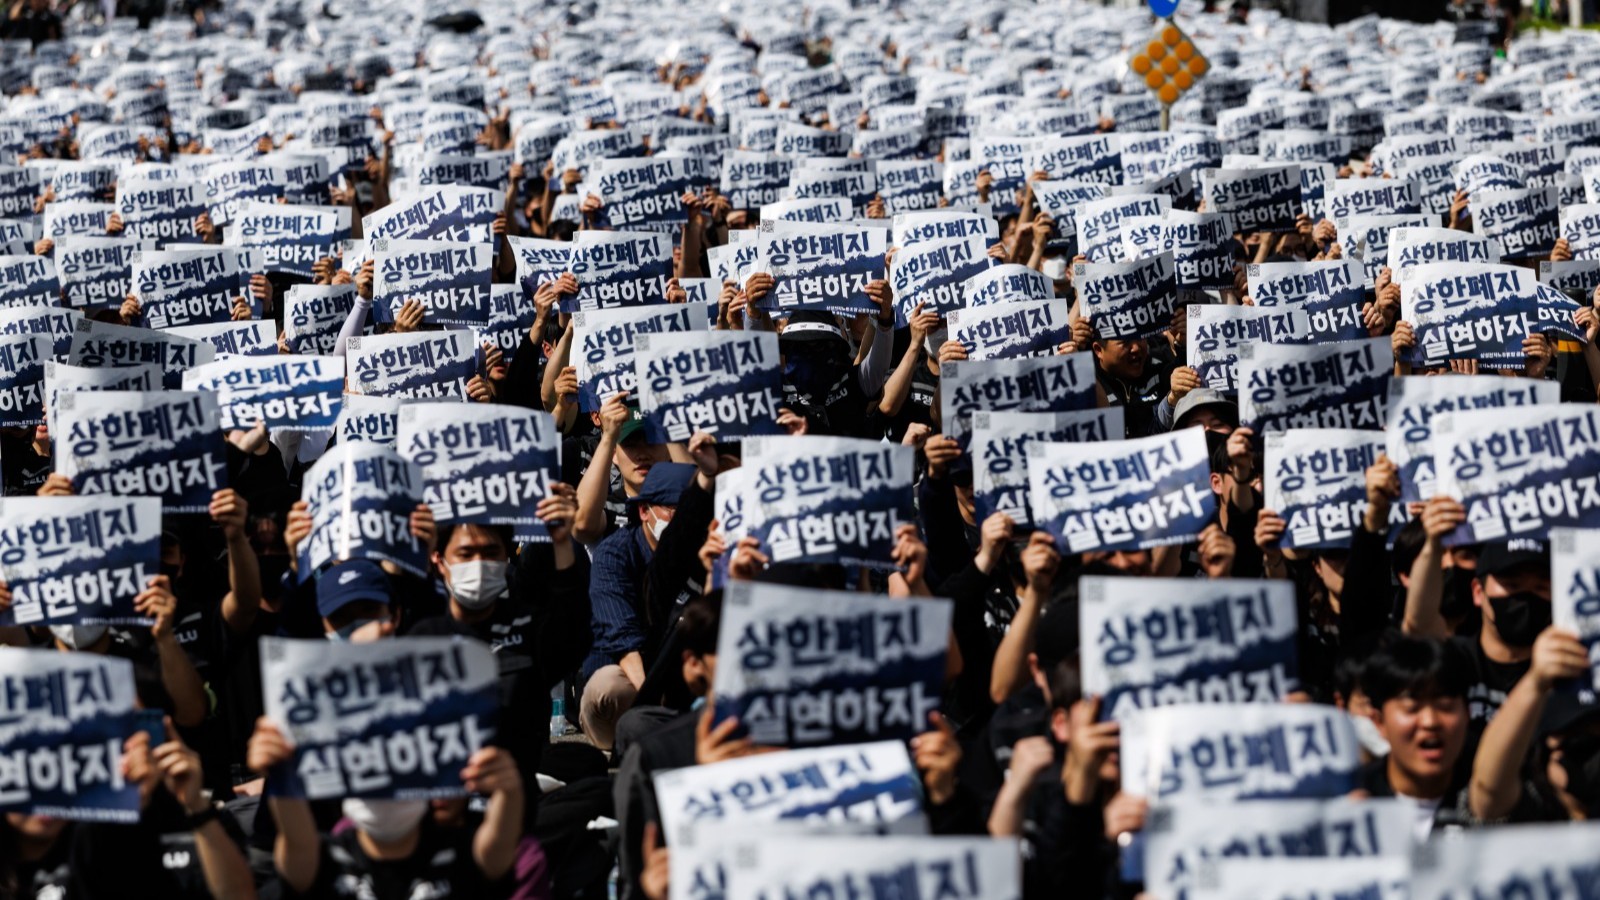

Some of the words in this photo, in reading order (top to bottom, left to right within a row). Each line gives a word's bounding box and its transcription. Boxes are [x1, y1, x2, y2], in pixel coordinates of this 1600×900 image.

[419, 162, 489, 185] 상한폐지
[729, 160, 793, 182] 상한폐지
[1040, 138, 1109, 172] 상한폐지
[206, 166, 274, 197] 상한폐지
[599, 160, 674, 195] 상한폐지
[794, 175, 865, 198] 상한폐지
[1044, 183, 1104, 210] 상한폐지
[1212, 169, 1289, 203] 상한폐지
[120, 186, 193, 214] 상한폐지
[608, 193, 682, 226] 실현하자
[1083, 198, 1160, 239] 상한폐지
[1231, 200, 1300, 228] 현하자
[1331, 184, 1412, 218] 상한폐지
[1479, 192, 1548, 227] 상한폐지
[241, 214, 322, 236] 상한폐지
[902, 218, 987, 246] 상한폐지
[1163, 216, 1228, 250] 상한폐지
[254, 243, 327, 266] 현하자
[381, 246, 477, 282] 상한폐지
[522, 248, 570, 264] 상한
[571, 235, 660, 274] 상한폐지
[766, 231, 869, 266] 상한폐지
[894, 240, 972, 290] 상한폐지
[1175, 252, 1236, 284] 현하자
[138, 252, 226, 293] 상한폐지
[775, 273, 873, 305] 실현하자
[1084, 257, 1164, 305] 상한폐지
[1256, 264, 1352, 306] 상한폐지
[1413, 270, 1521, 313] 상한폐지
[68, 279, 132, 306] 실현하
[147, 290, 237, 329] 실현하자
[390, 284, 489, 316] 실현하자
[577, 276, 668, 310] 실현하자
[0, 312, 74, 336] 한폐지
[583, 307, 692, 363] 상한폐지
[956, 304, 1053, 353] 상한폐지
[1095, 292, 1177, 339] 실현하자
[1195, 312, 1295, 352] 상한폐지
[1307, 303, 1363, 339] 하자
[79, 339, 197, 367] 상한폐지
[202, 323, 262, 356] 폐지
[355, 335, 460, 382] 상한폐지
[1421, 312, 1538, 366] 실현하자
[646, 337, 765, 392] 상한폐지
[1248, 344, 1374, 402] 상한폐지
[952, 359, 1078, 418] 상한폐지
[69, 397, 205, 457] 상한폐지
[344, 411, 398, 443] 상한
[662, 388, 783, 442] 실현하자
[410, 414, 540, 466] 상한폐지
[1450, 412, 1598, 480] 상한폐지
[756, 449, 893, 503] 상한폐지
[1044, 439, 1182, 498] 상한폐지
[423, 467, 552, 522] 실현하자
[2, 503, 138, 564] 상한폐지
[766, 507, 901, 562] 실현하자
[1062, 483, 1212, 552] 실현하자
[11, 562, 158, 623] 실현하자
[738, 606, 920, 670] 상한폐지
[1097, 591, 1275, 667] 상한폐지
[280, 646, 467, 726] 상한폐지
[743, 682, 942, 743] 실현하자
[298, 715, 496, 800] 실현하자
